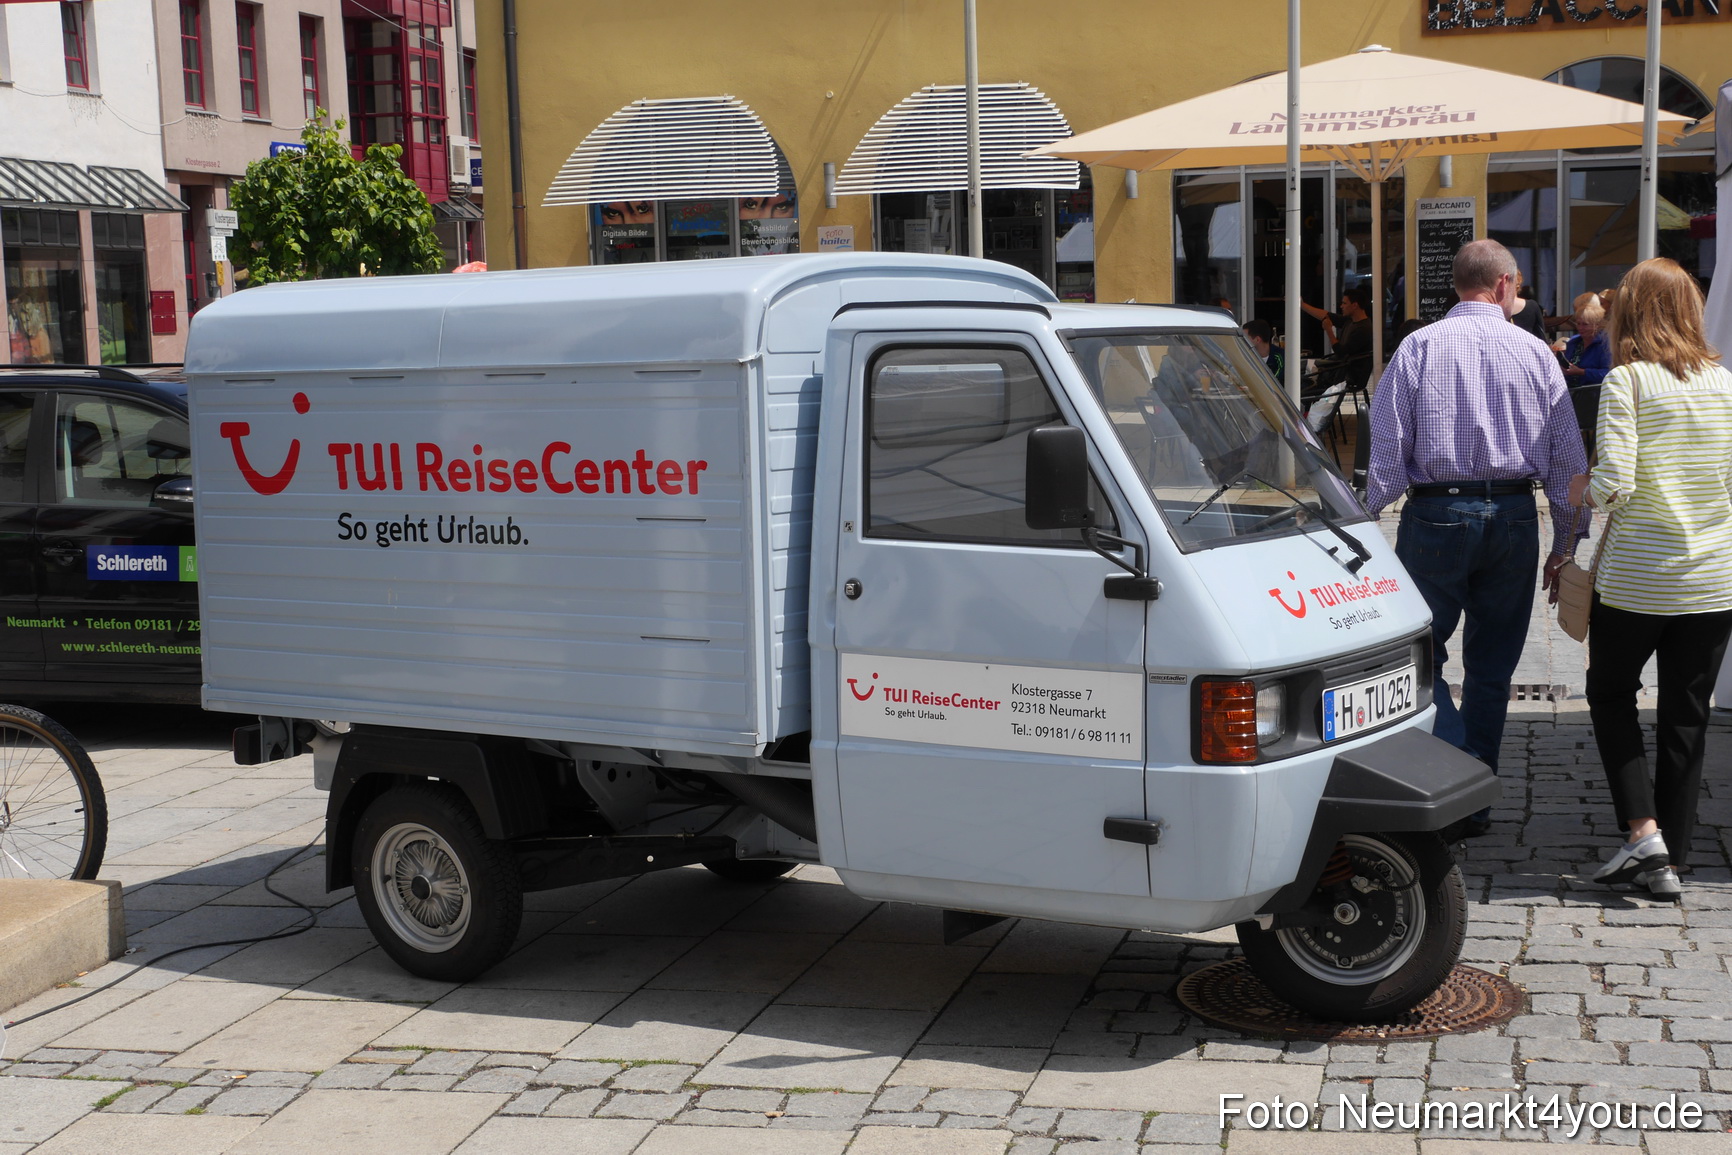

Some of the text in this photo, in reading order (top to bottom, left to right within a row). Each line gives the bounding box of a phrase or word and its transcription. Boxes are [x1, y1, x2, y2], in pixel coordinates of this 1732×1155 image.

[185, 157, 217, 168] Klostergasse
[1420, 201, 1471, 210] BELACCANTO
[602, 229, 648, 238] Digitale Bilder
[753, 224, 789, 232] Passbilder
[825, 229, 843, 239] FOTO
[820, 237, 851, 246] hailer
[328, 441, 708, 496] TUI ReiseCenter
[337, 512, 530, 547] So geht Urlaub.
[97, 553, 168, 572] Schlereth
[1309, 576, 1400, 609] TUI ReiseCenter
[6, 616, 66, 629] Neumarkt
[85, 617, 132, 630] Telefon
[134, 619, 172, 631] 09181
[1329, 607, 1383, 630] So geht Urlaub.
[61, 641, 202, 655] www.schlereth-neuma
[883, 687, 1002, 711] TUI ReiseCenter
[1011, 683, 1093, 701] Klostergasse 7
[1327, 673, 1411, 732] D H TU 252
[884, 707, 947, 721] So geht Urlaub.
[1011, 701, 1107, 720] 92318 Neumarkt
[1011, 723, 1032, 736] Tel.:
